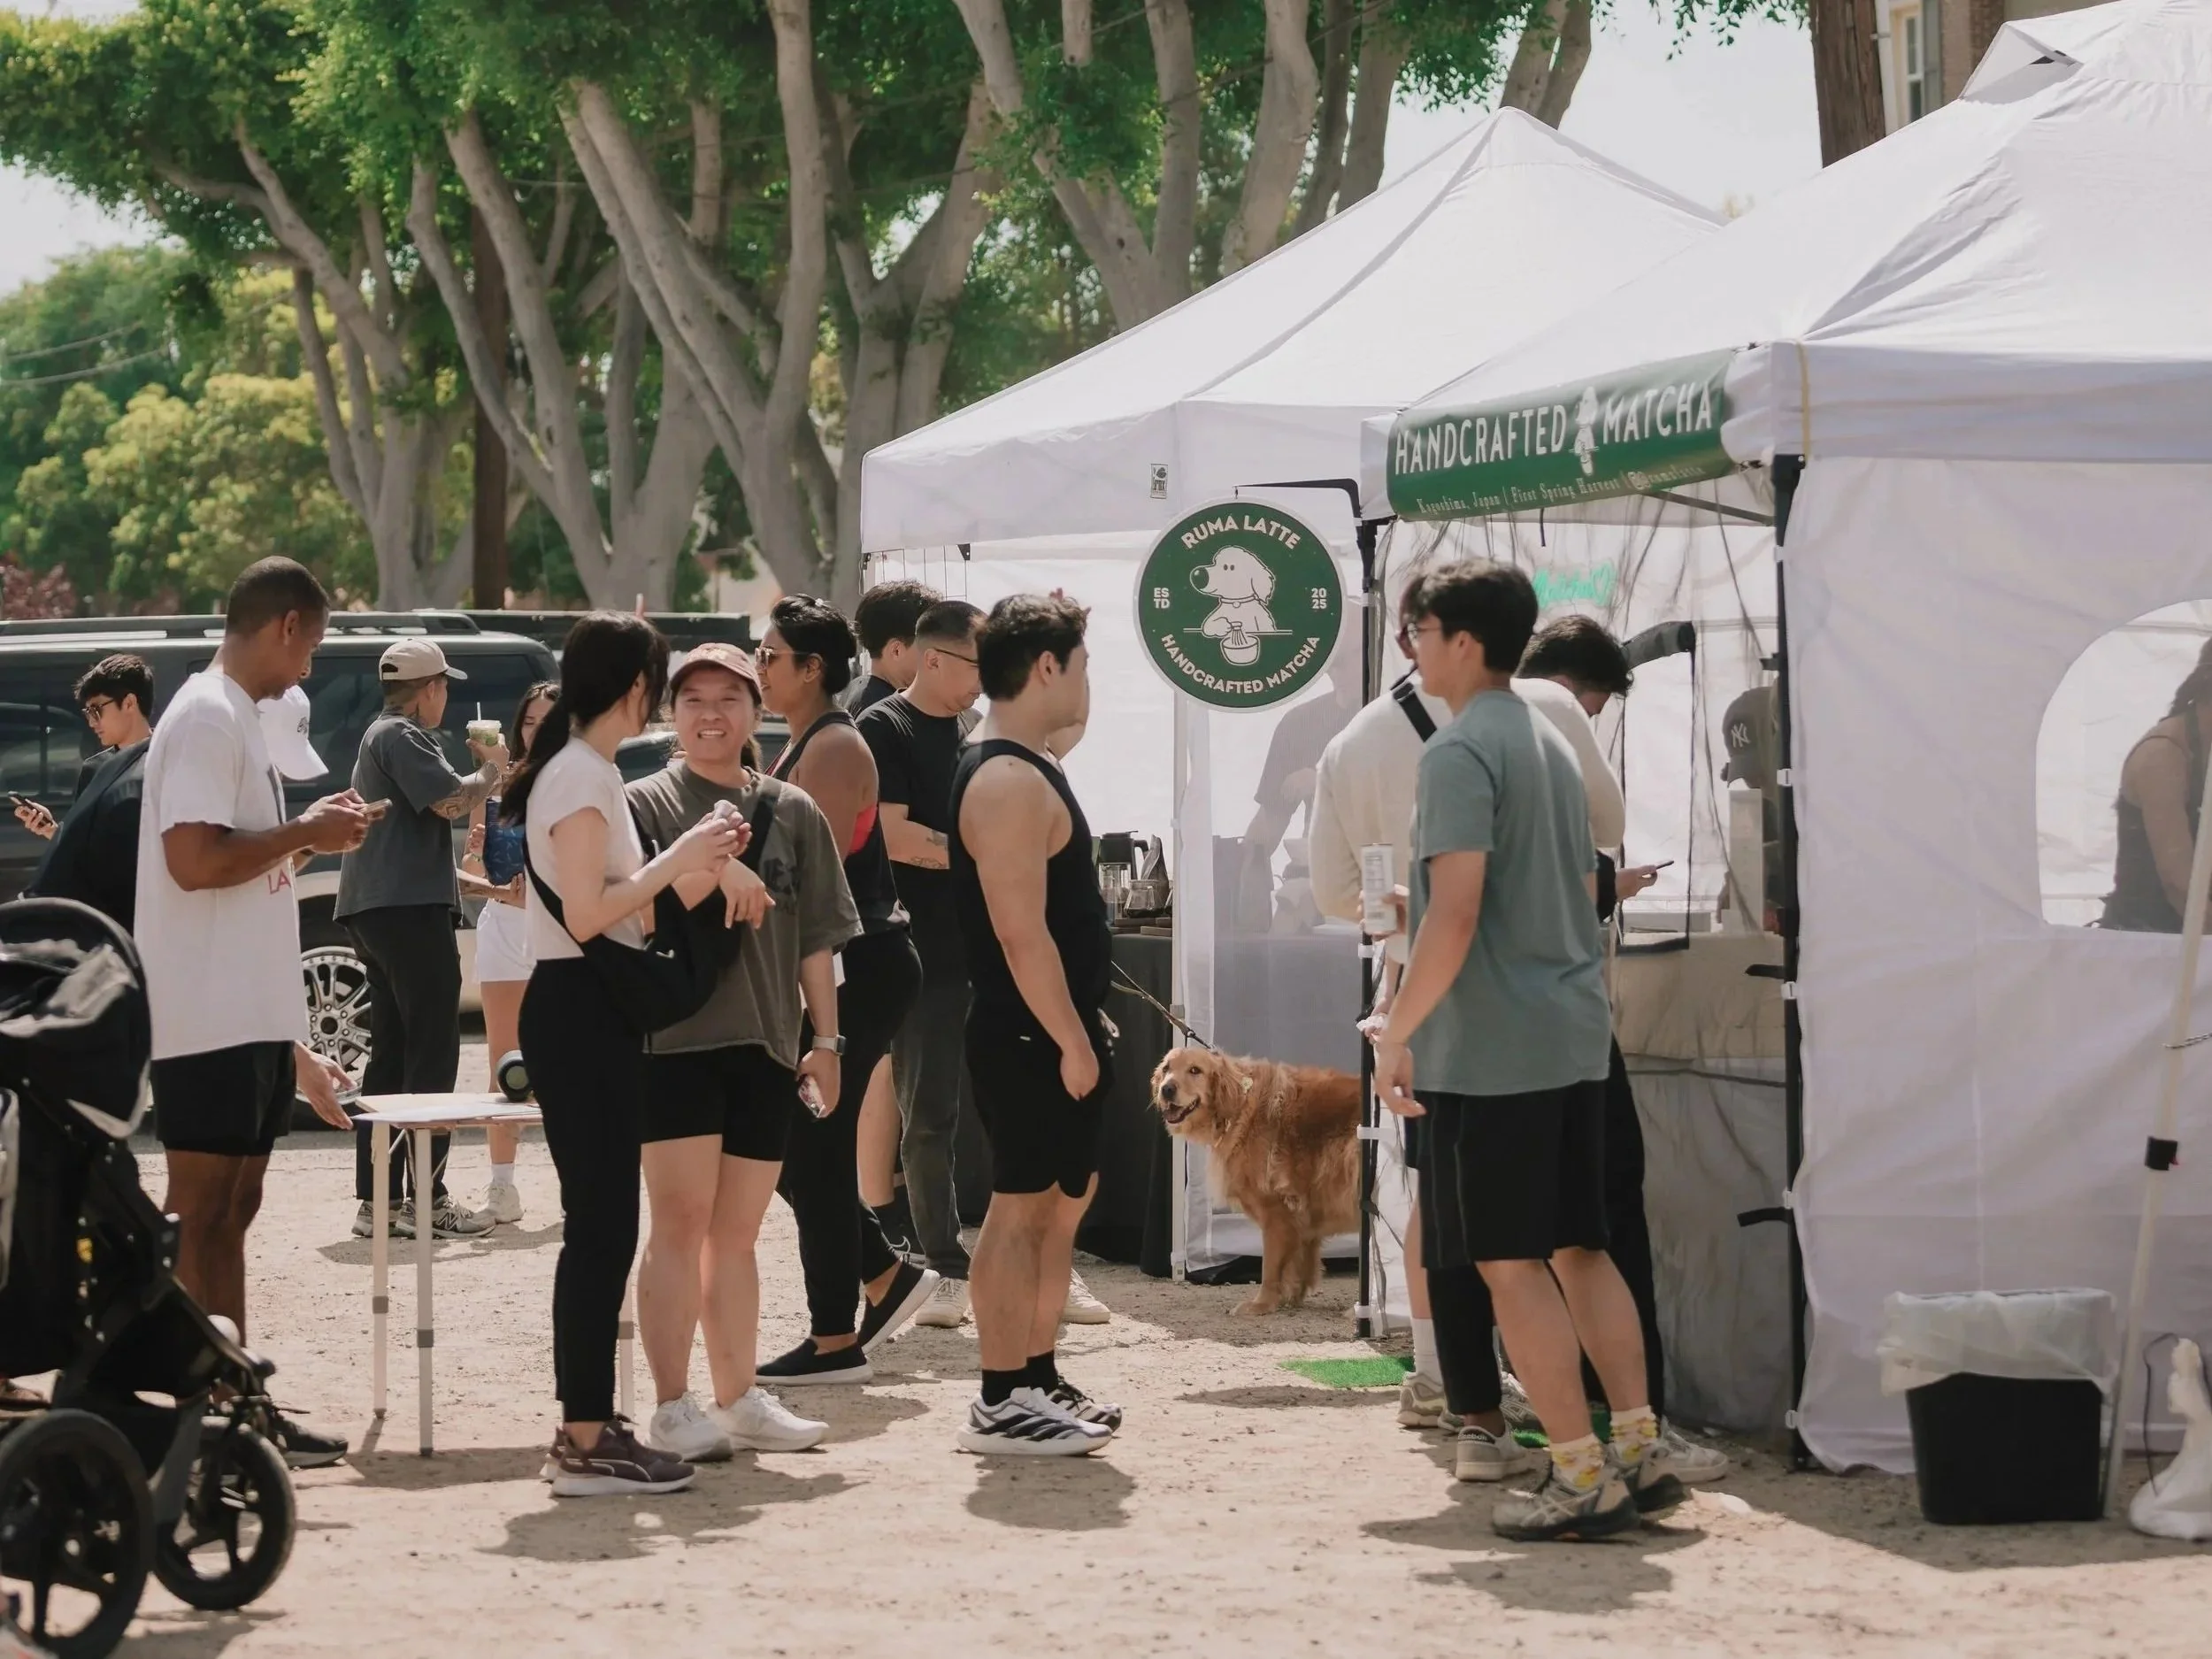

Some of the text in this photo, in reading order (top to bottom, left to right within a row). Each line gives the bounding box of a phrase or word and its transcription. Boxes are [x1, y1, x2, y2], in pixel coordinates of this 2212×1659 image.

[1395, 380, 1713, 475] HANDCRAFTED MATCHA
[1472, 491, 1502, 511] Japan
[1510, 487, 1538, 503] First
[1540, 482, 1576, 503] Spring
[1180, 515, 1302, 549] RUMA LATTE
[1154, 588, 1170, 598] ES
[1154, 598, 1170, 609] TD
[1311, 588, 1327, 598] 20
[1312, 598, 1327, 609] 25
[1161, 634, 1320, 695] HANDCRAFTED MATCHA
[1731, 722, 1751, 749] NY
